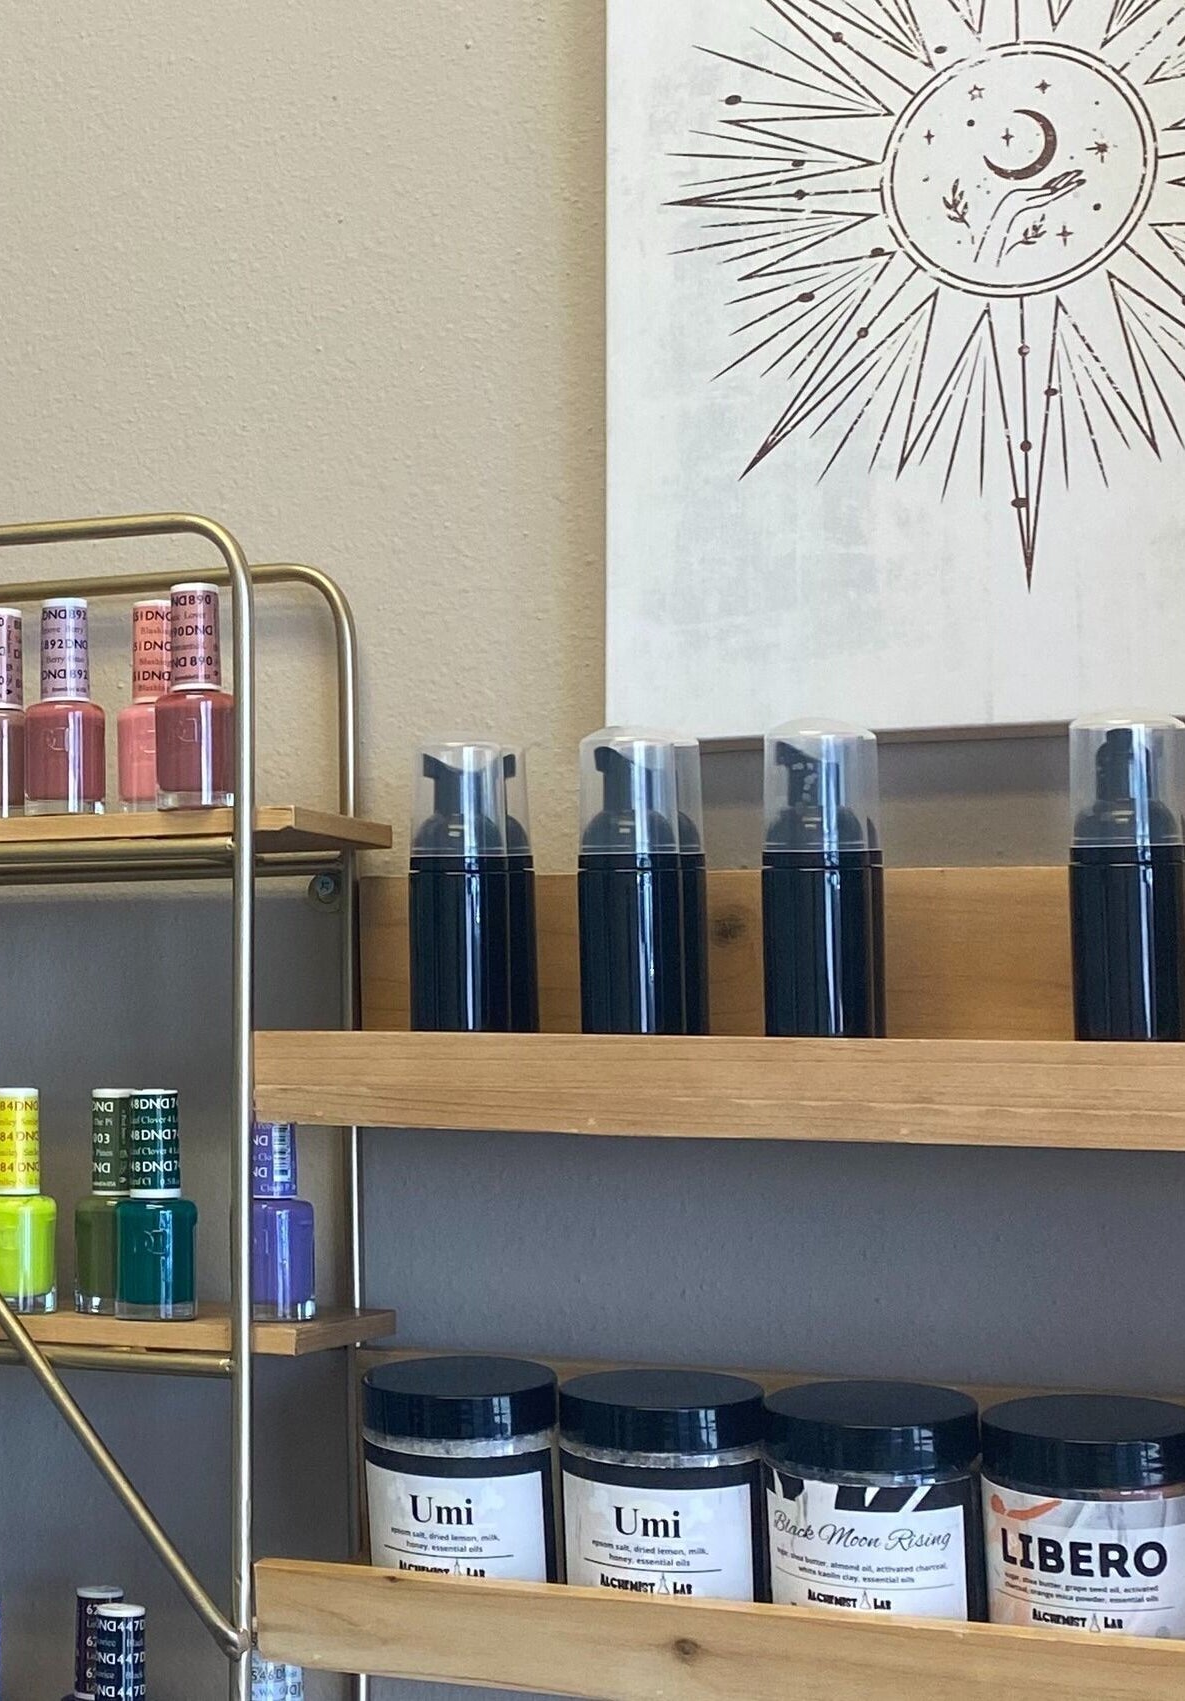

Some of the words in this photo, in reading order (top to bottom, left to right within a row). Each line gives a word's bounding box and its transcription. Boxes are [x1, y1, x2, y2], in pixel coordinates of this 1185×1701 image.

[408, 1493, 474, 1526] Umi
[613, 1505, 682, 1539] Umi
[773, 1509, 816, 1541] Black
[818, 1522, 881, 1548] Moon
[884, 1528, 952, 1551] Rising
[429, 1532, 450, 1541] dried
[431, 1544, 467, 1553] essential
[469, 1545, 483, 1553] oils
[634, 1546, 656, 1555] dried
[1001, 1527, 1168, 1578] LIBERO
[636, 1557, 674, 1567] essential
[675, 1558, 691, 1567] oils
